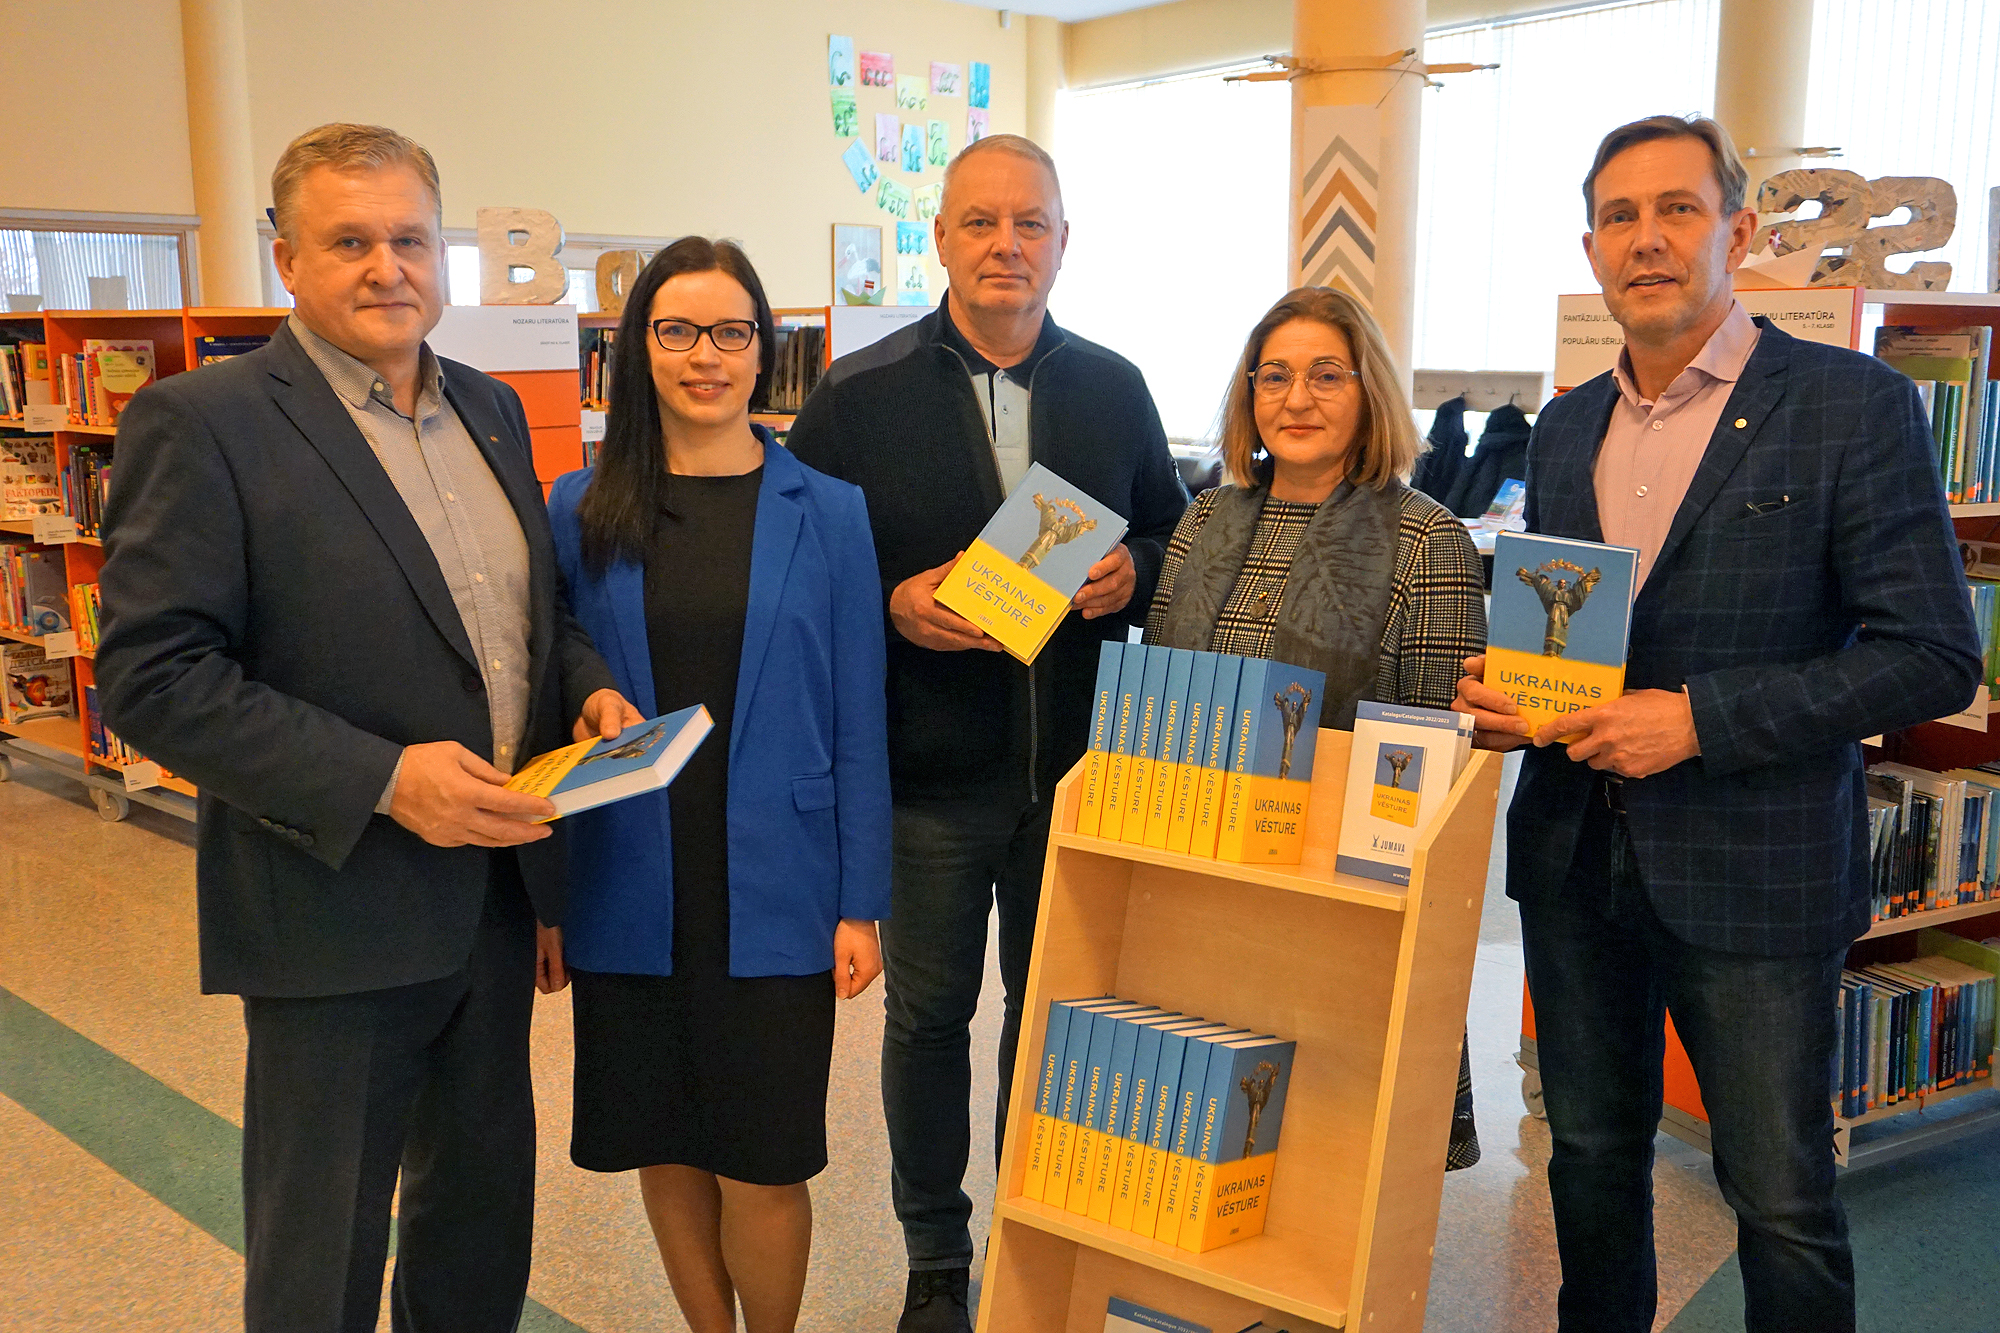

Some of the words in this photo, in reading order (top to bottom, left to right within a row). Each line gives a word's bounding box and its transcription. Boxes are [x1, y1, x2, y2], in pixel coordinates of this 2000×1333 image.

[1562, 336, 1600, 345] POPULĀRU
[1563, 313, 1601, 322] FANTĀZIJU
[1780, 310, 1835, 320] LITERATŪRA
[966, 577, 1033, 628] VĒSTURE
[971, 560, 1047, 615] UKRAINAS
[1500, 670, 1602, 699] UKRAINAS
[1094, 691, 1108, 750] UKRAINAS
[1118, 694, 1131, 753] UKRAINAS
[1140, 697, 1154, 756] UKRAINAS
[1163, 700, 1177, 760] UKRAINAS
[1186, 703, 1201, 764] UKRAINAS
[1210, 706, 1224, 767] UKRAINAS
[1236, 710, 1251, 772] UKRAINAS
[1087, 754, 1099, 807] VĒSTURE
[1110, 757, 1122, 810] VĒSTURE
[1132, 761, 1145, 814] VĒSTURE
[1154, 765, 1168, 819] VĒSTURE
[1178, 768, 1191, 822] VĒSTURE
[1201, 772, 1215, 827] VĒSTURE
[1228, 777, 1242, 831] VĒSTURE
[1255, 799, 1302, 814] UKRAINAS
[1376, 793, 1410, 806] UKRAINAS
[1378, 800, 1408, 814] VĒSTURE
[1255, 818, 1296, 834] VĒSTURE
[1380, 840, 1405, 852] JUMAVA
[1041, 1054, 1055, 1114] UKRAINAS
[1063, 1060, 1077, 1120] UKRAINAS
[1085, 1067, 1100, 1127] UKRAINAS
[1107, 1073, 1122, 1134] UKRAINAS
[1130, 1079, 1146, 1140] UKRAINAS
[1153, 1086, 1168, 1147] UKRAINAS
[1177, 1091, 1193, 1154] UKRAINAS
[1200, 1098, 1217, 1160] UKRAINAS
[1032, 1118, 1045, 1171] VĒSTURE
[1054, 1125, 1068, 1178] VĒSTURE
[1076, 1131, 1090, 1185] VĒSTURE
[1098, 1138, 1112, 1192] VĒSTURE
[1121, 1145, 1135, 1200] VĒSTURE
[1143, 1152, 1157, 1207] VĒSTURE
[1167, 1159, 1182, 1214] VĒSTURE
[1190, 1166, 1205, 1221] VĒSTURE
[1217, 1174, 1266, 1198] UKRAINAS
[1217, 1196, 1260, 1218] VĒSTURE
